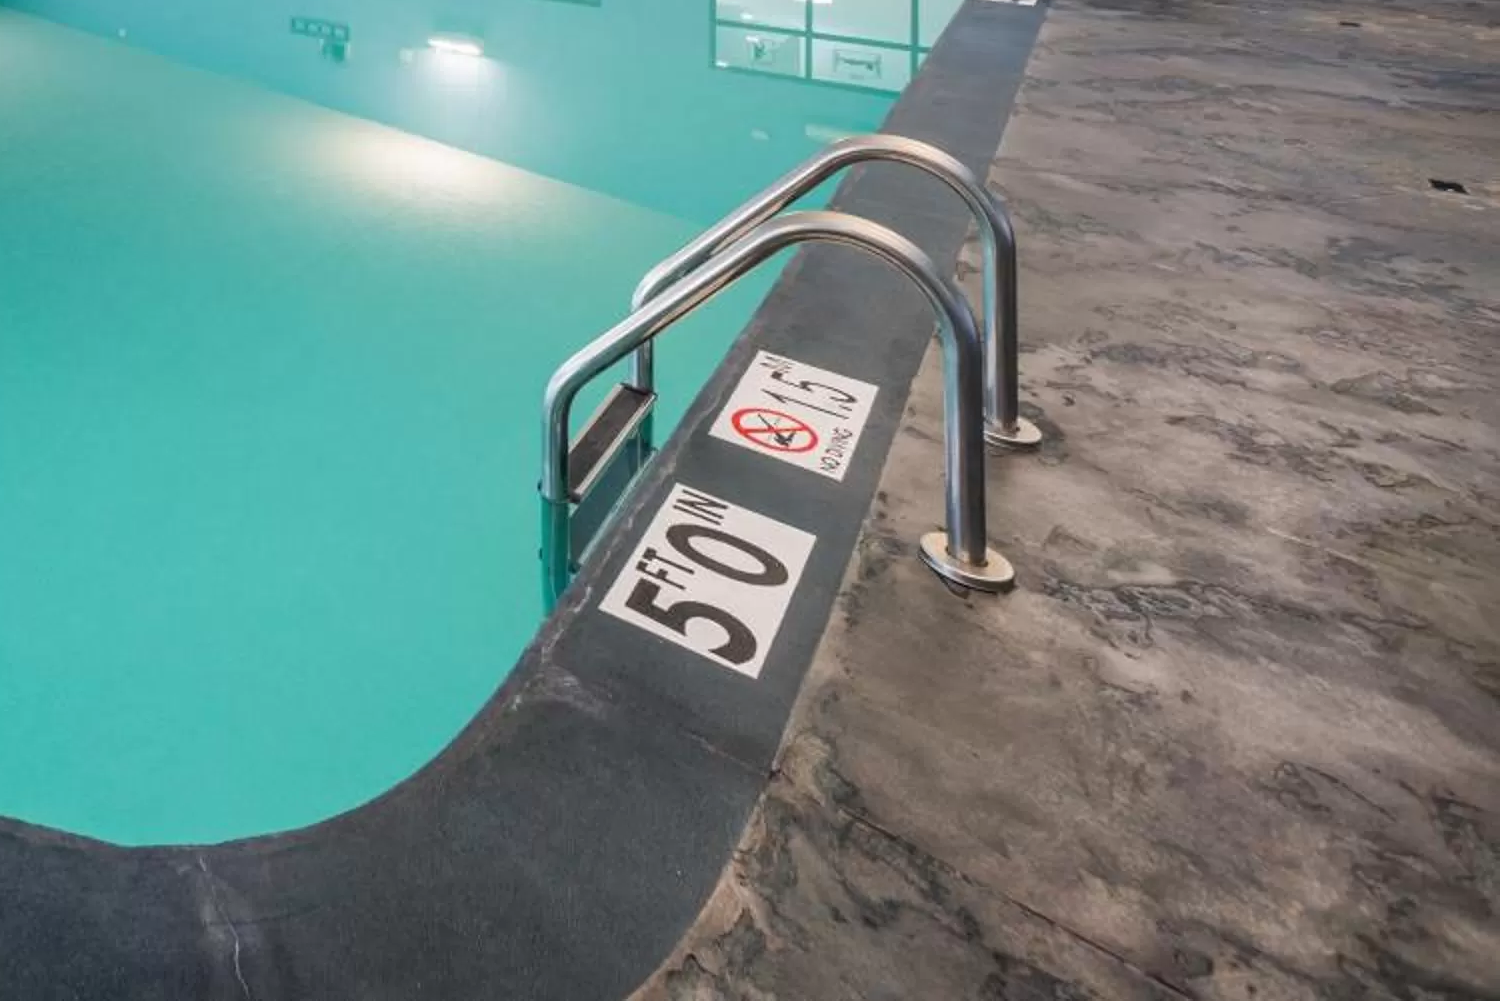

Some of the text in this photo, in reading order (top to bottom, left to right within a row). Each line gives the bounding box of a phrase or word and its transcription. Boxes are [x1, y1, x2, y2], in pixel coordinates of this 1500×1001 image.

[825, 426, 853, 458] DIVING
[624, 488, 789, 665] 5 FT 0 IN
